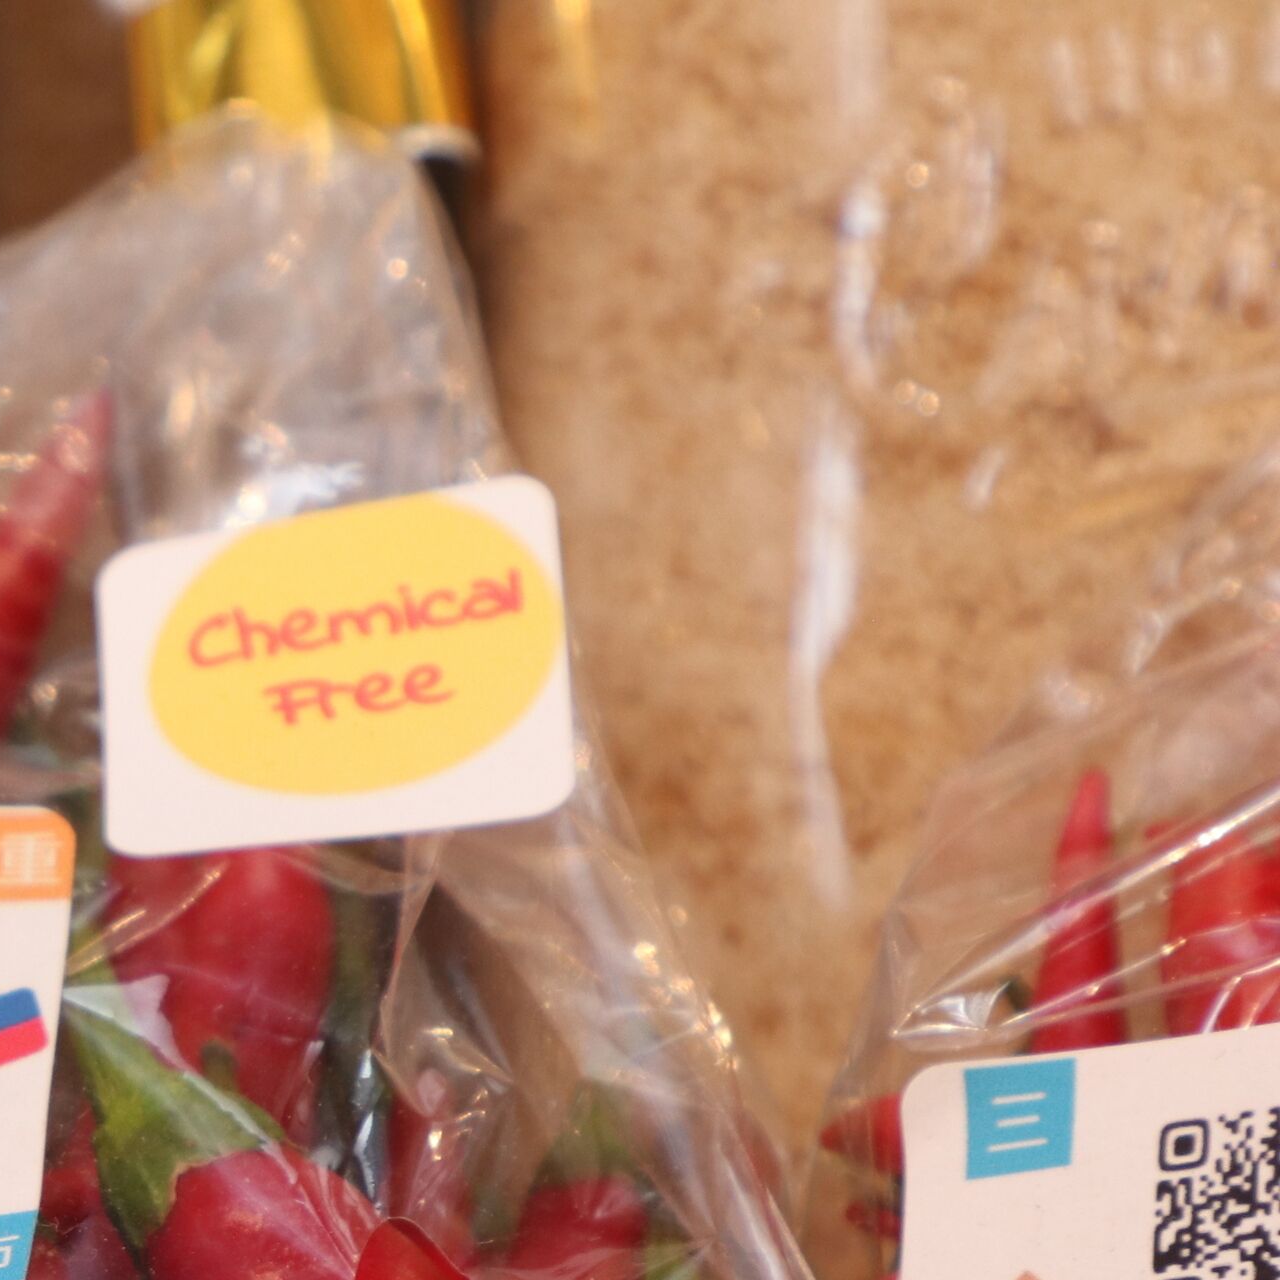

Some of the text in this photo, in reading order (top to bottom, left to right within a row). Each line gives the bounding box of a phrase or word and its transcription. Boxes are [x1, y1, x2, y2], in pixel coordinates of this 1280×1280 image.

[186, 566, 525, 670] Chemical
[260, 662, 457, 727] Free
[987, 1091, 1049, 1154] 三
